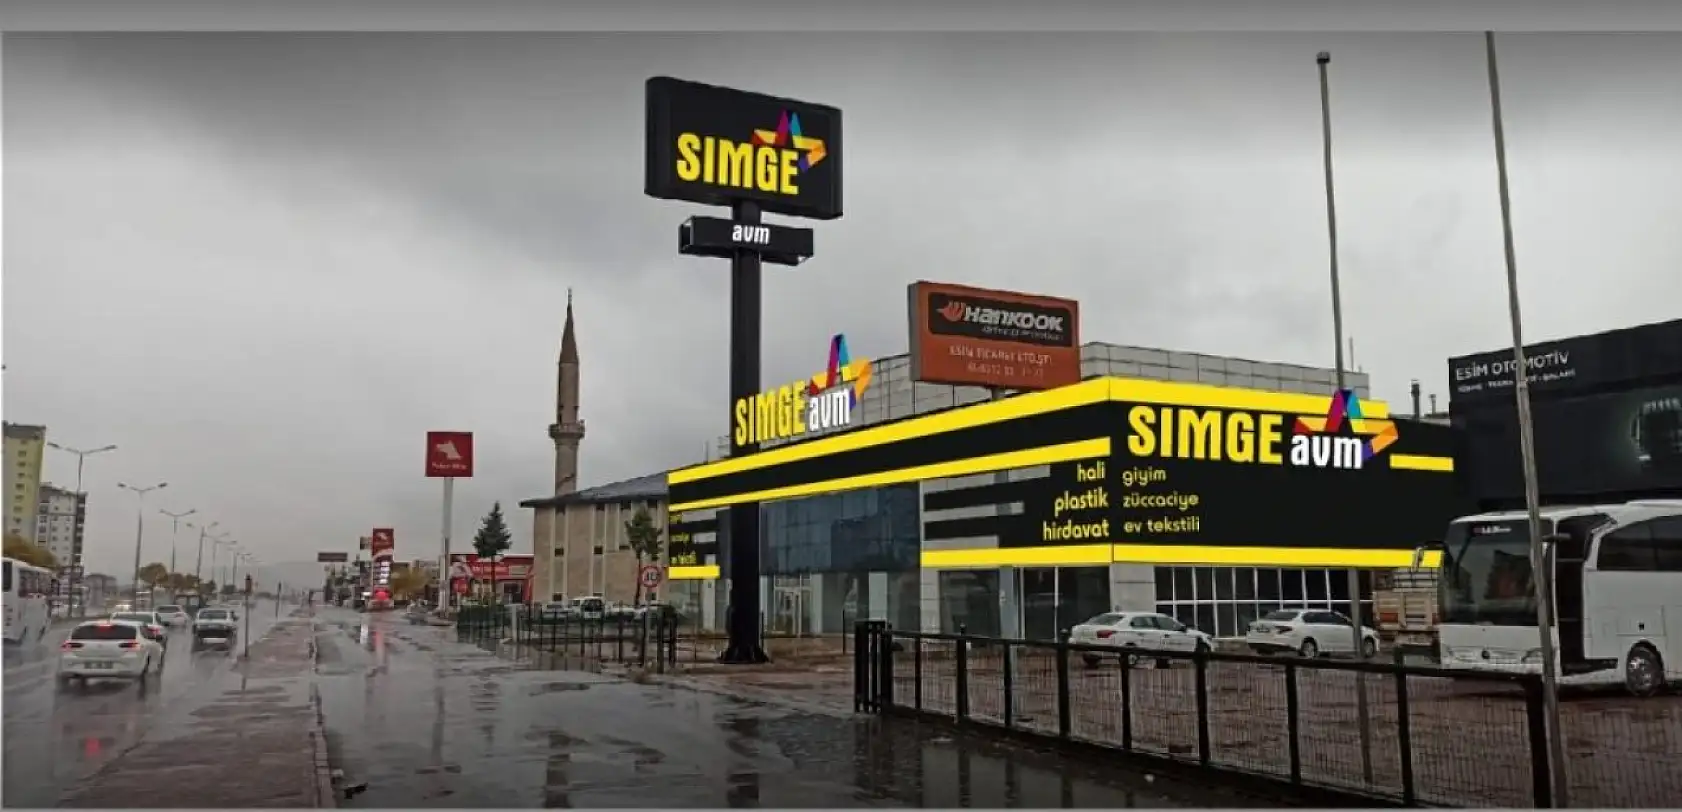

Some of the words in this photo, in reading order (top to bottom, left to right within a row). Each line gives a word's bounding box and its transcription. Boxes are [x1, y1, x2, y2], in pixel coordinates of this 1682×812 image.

[677, 133, 799, 195] SIMGE
[732, 224, 770, 244] avm
[735, 380, 806, 446] SIMGE
[809, 388, 850, 431] avm
[1128, 405, 1283, 465] SIMGE
[1291, 434, 1363, 469] avm
[1122, 467, 1167, 487] giyim
[1054, 487, 1109, 517] plastik
[1122, 491, 1199, 511] züccaciye
[1124, 522, 1143, 533] ev
[1147, 516, 1200, 533] tekstili
